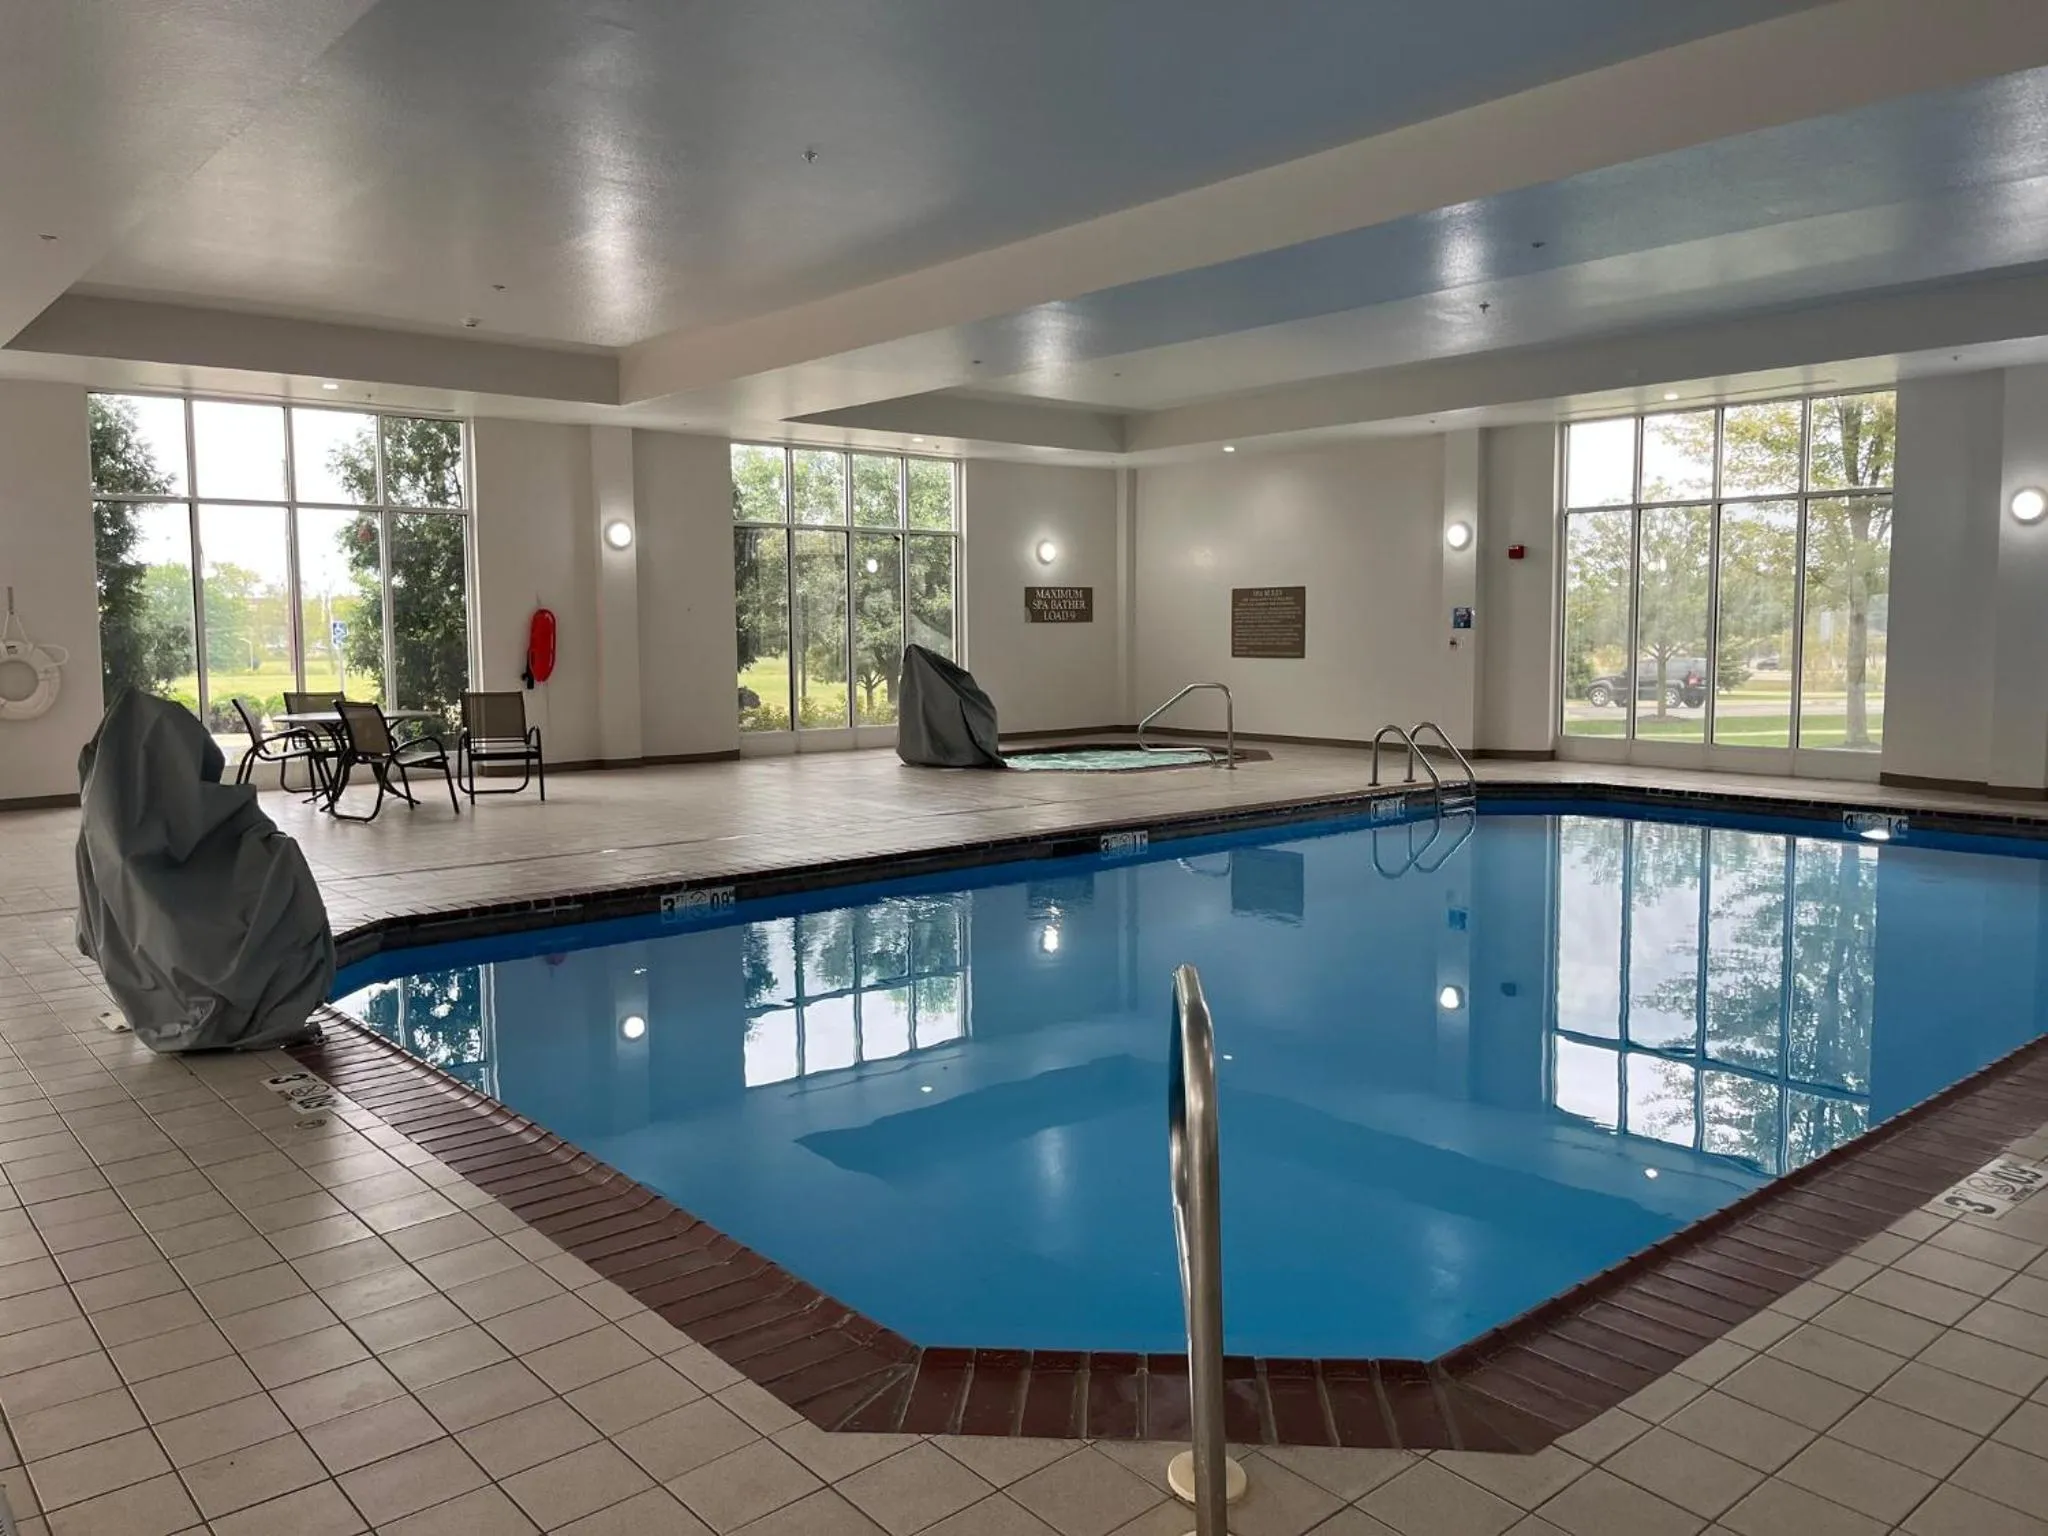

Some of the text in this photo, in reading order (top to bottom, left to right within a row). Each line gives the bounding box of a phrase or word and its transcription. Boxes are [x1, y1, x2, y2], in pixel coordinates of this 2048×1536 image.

[1036, 589, 1083, 599] MAXIMUM
[1032, 600, 1087, 610] SPA BATHER
[1944, 1196, 1997, 1214] 3
